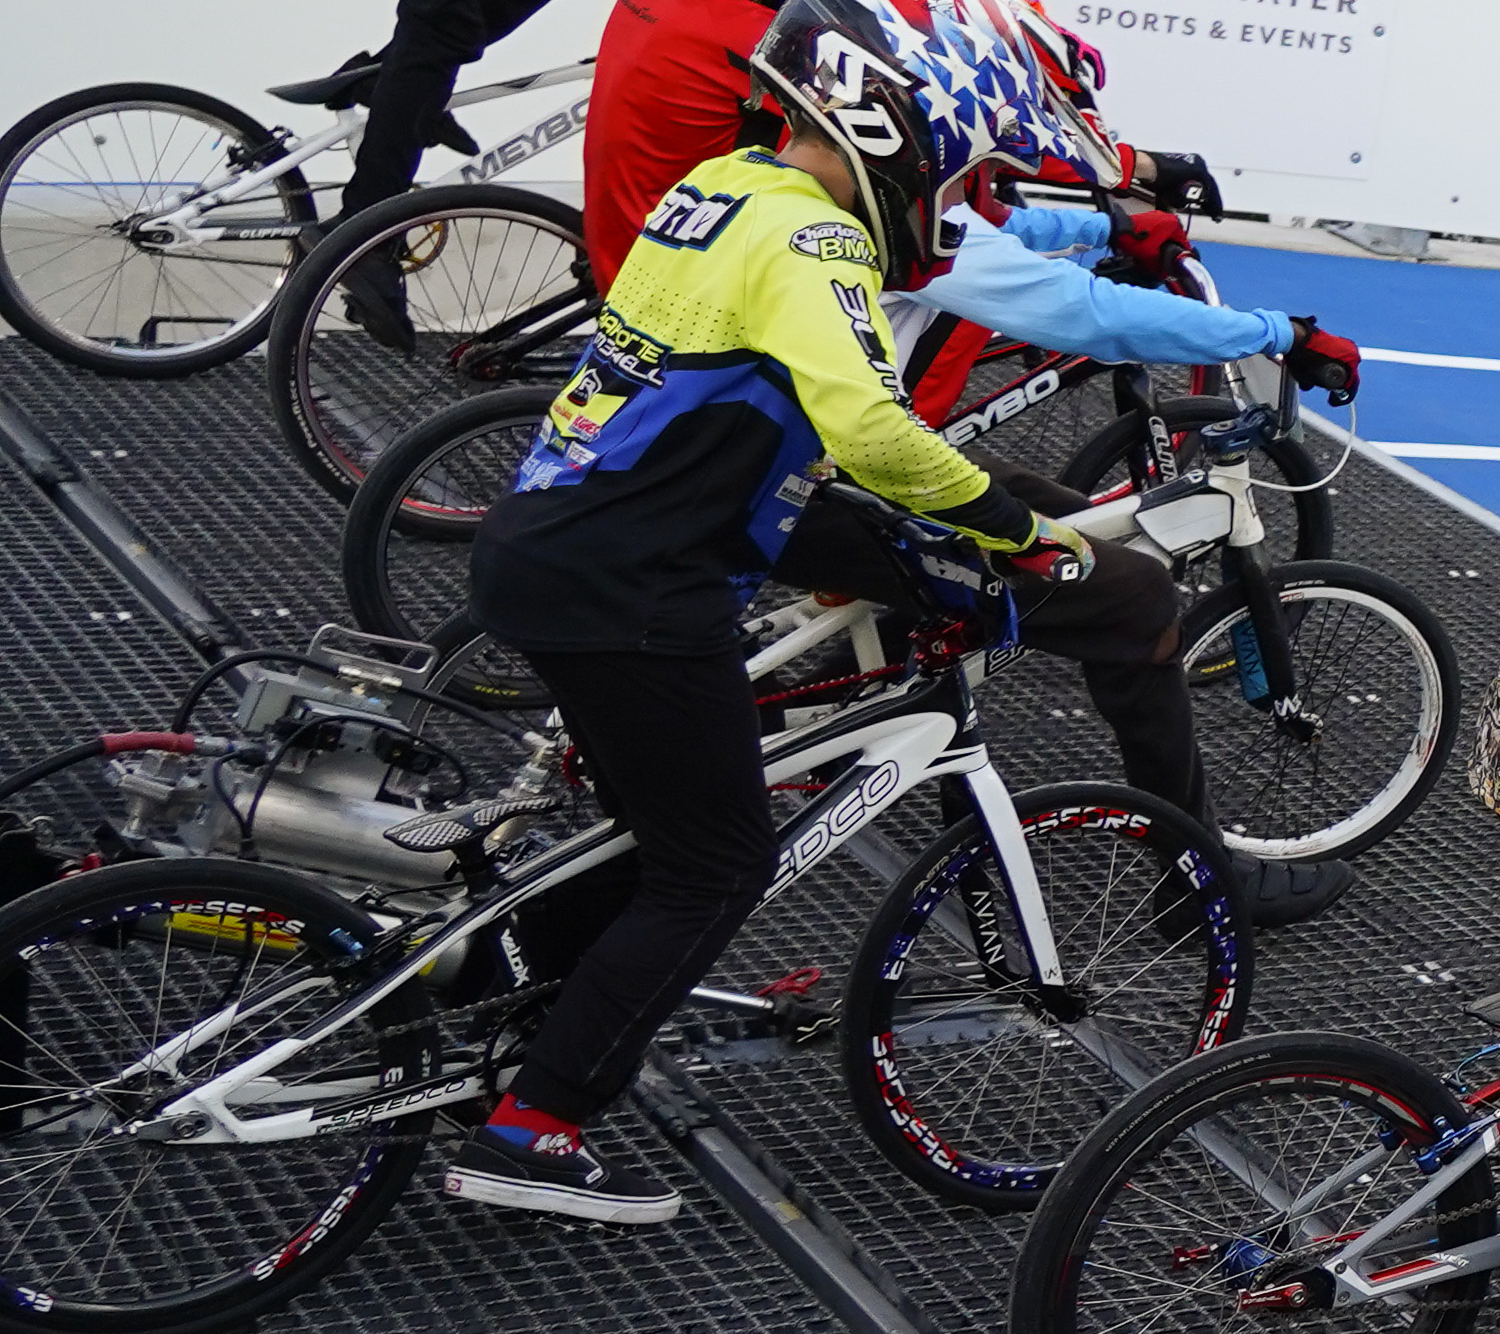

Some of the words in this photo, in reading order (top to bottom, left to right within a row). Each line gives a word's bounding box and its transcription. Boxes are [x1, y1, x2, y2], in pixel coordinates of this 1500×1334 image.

[1076, 3, 1198, 38] SPORTS
[1209, 19, 1228, 41] &
[1240, 24, 1353, 56] EVENTS
[943, 368, 1061, 448] EYBO
[971, 889, 1006, 963] AVIAN
